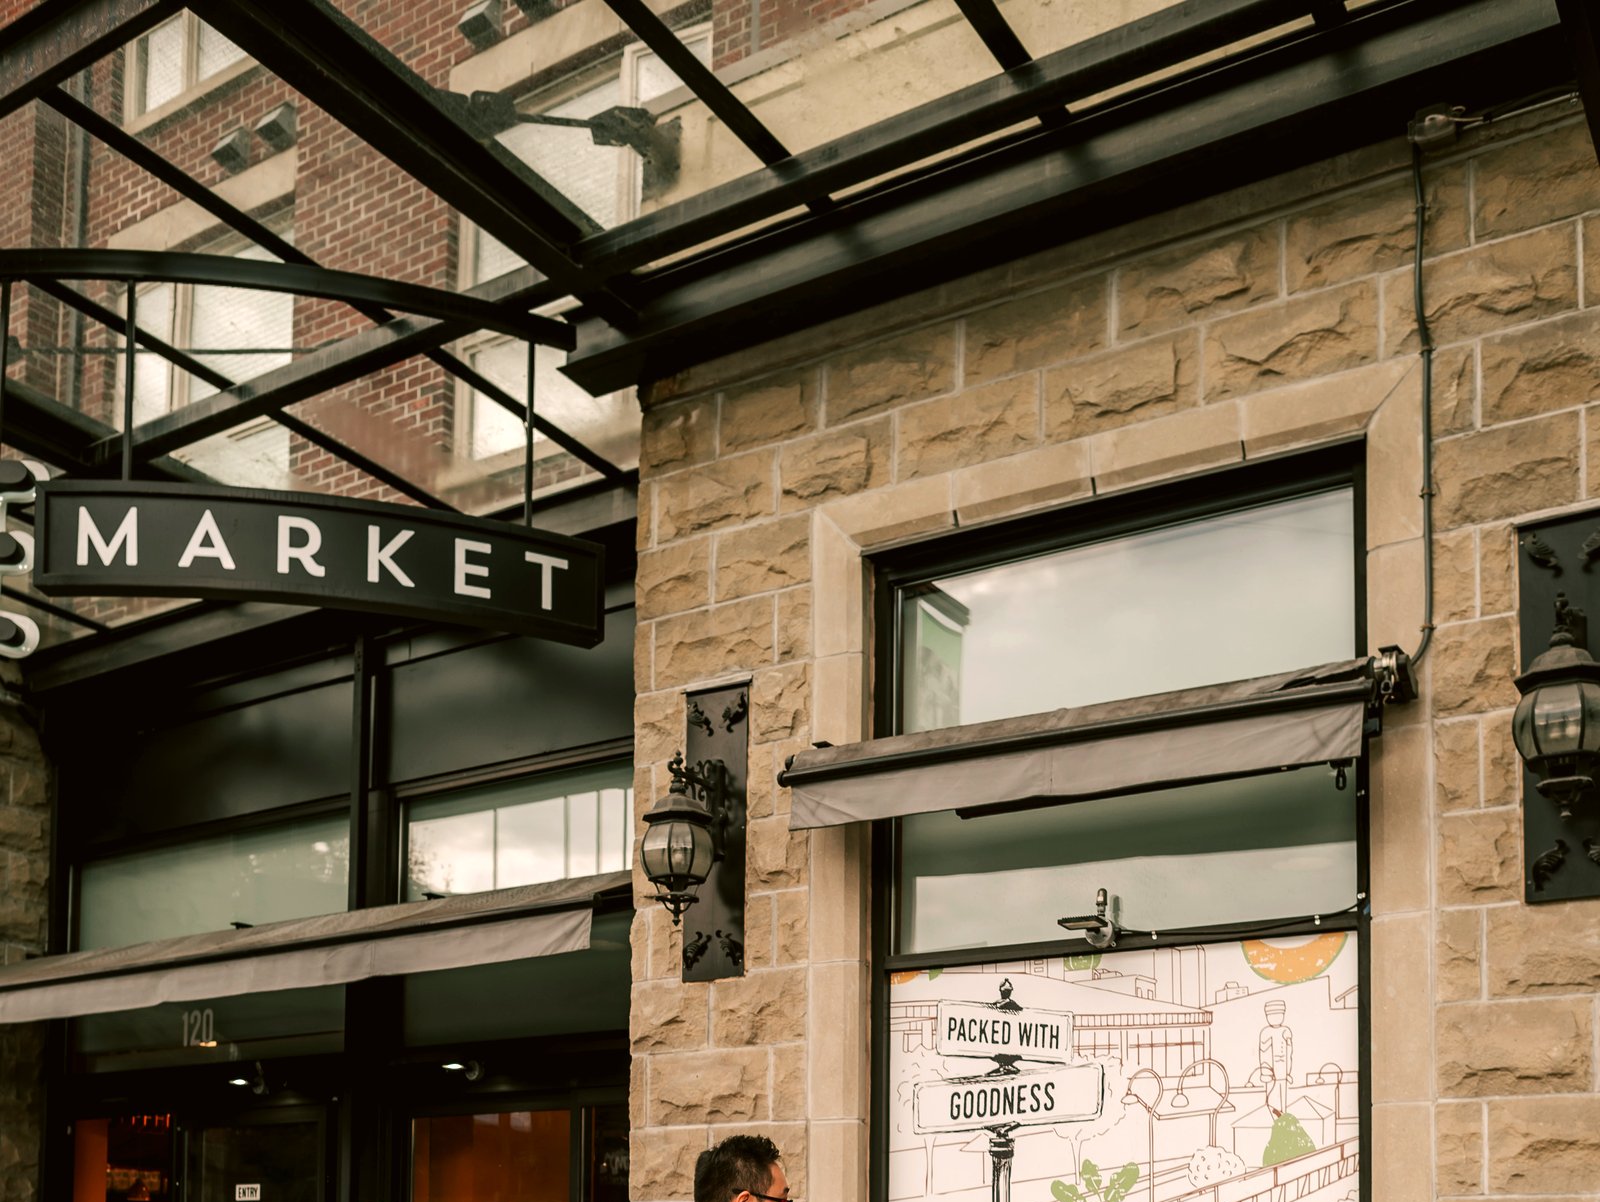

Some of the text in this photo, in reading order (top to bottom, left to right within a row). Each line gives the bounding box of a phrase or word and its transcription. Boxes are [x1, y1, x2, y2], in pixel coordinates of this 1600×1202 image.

[76, 505, 569, 610] MARKET
[182, 1008, 213, 1048] 120
[947, 1017, 1060, 1050] PACKED WITH
[950, 1082, 1055, 1120] GOODNESS
[238, 1186, 259, 1199] ENTRY
